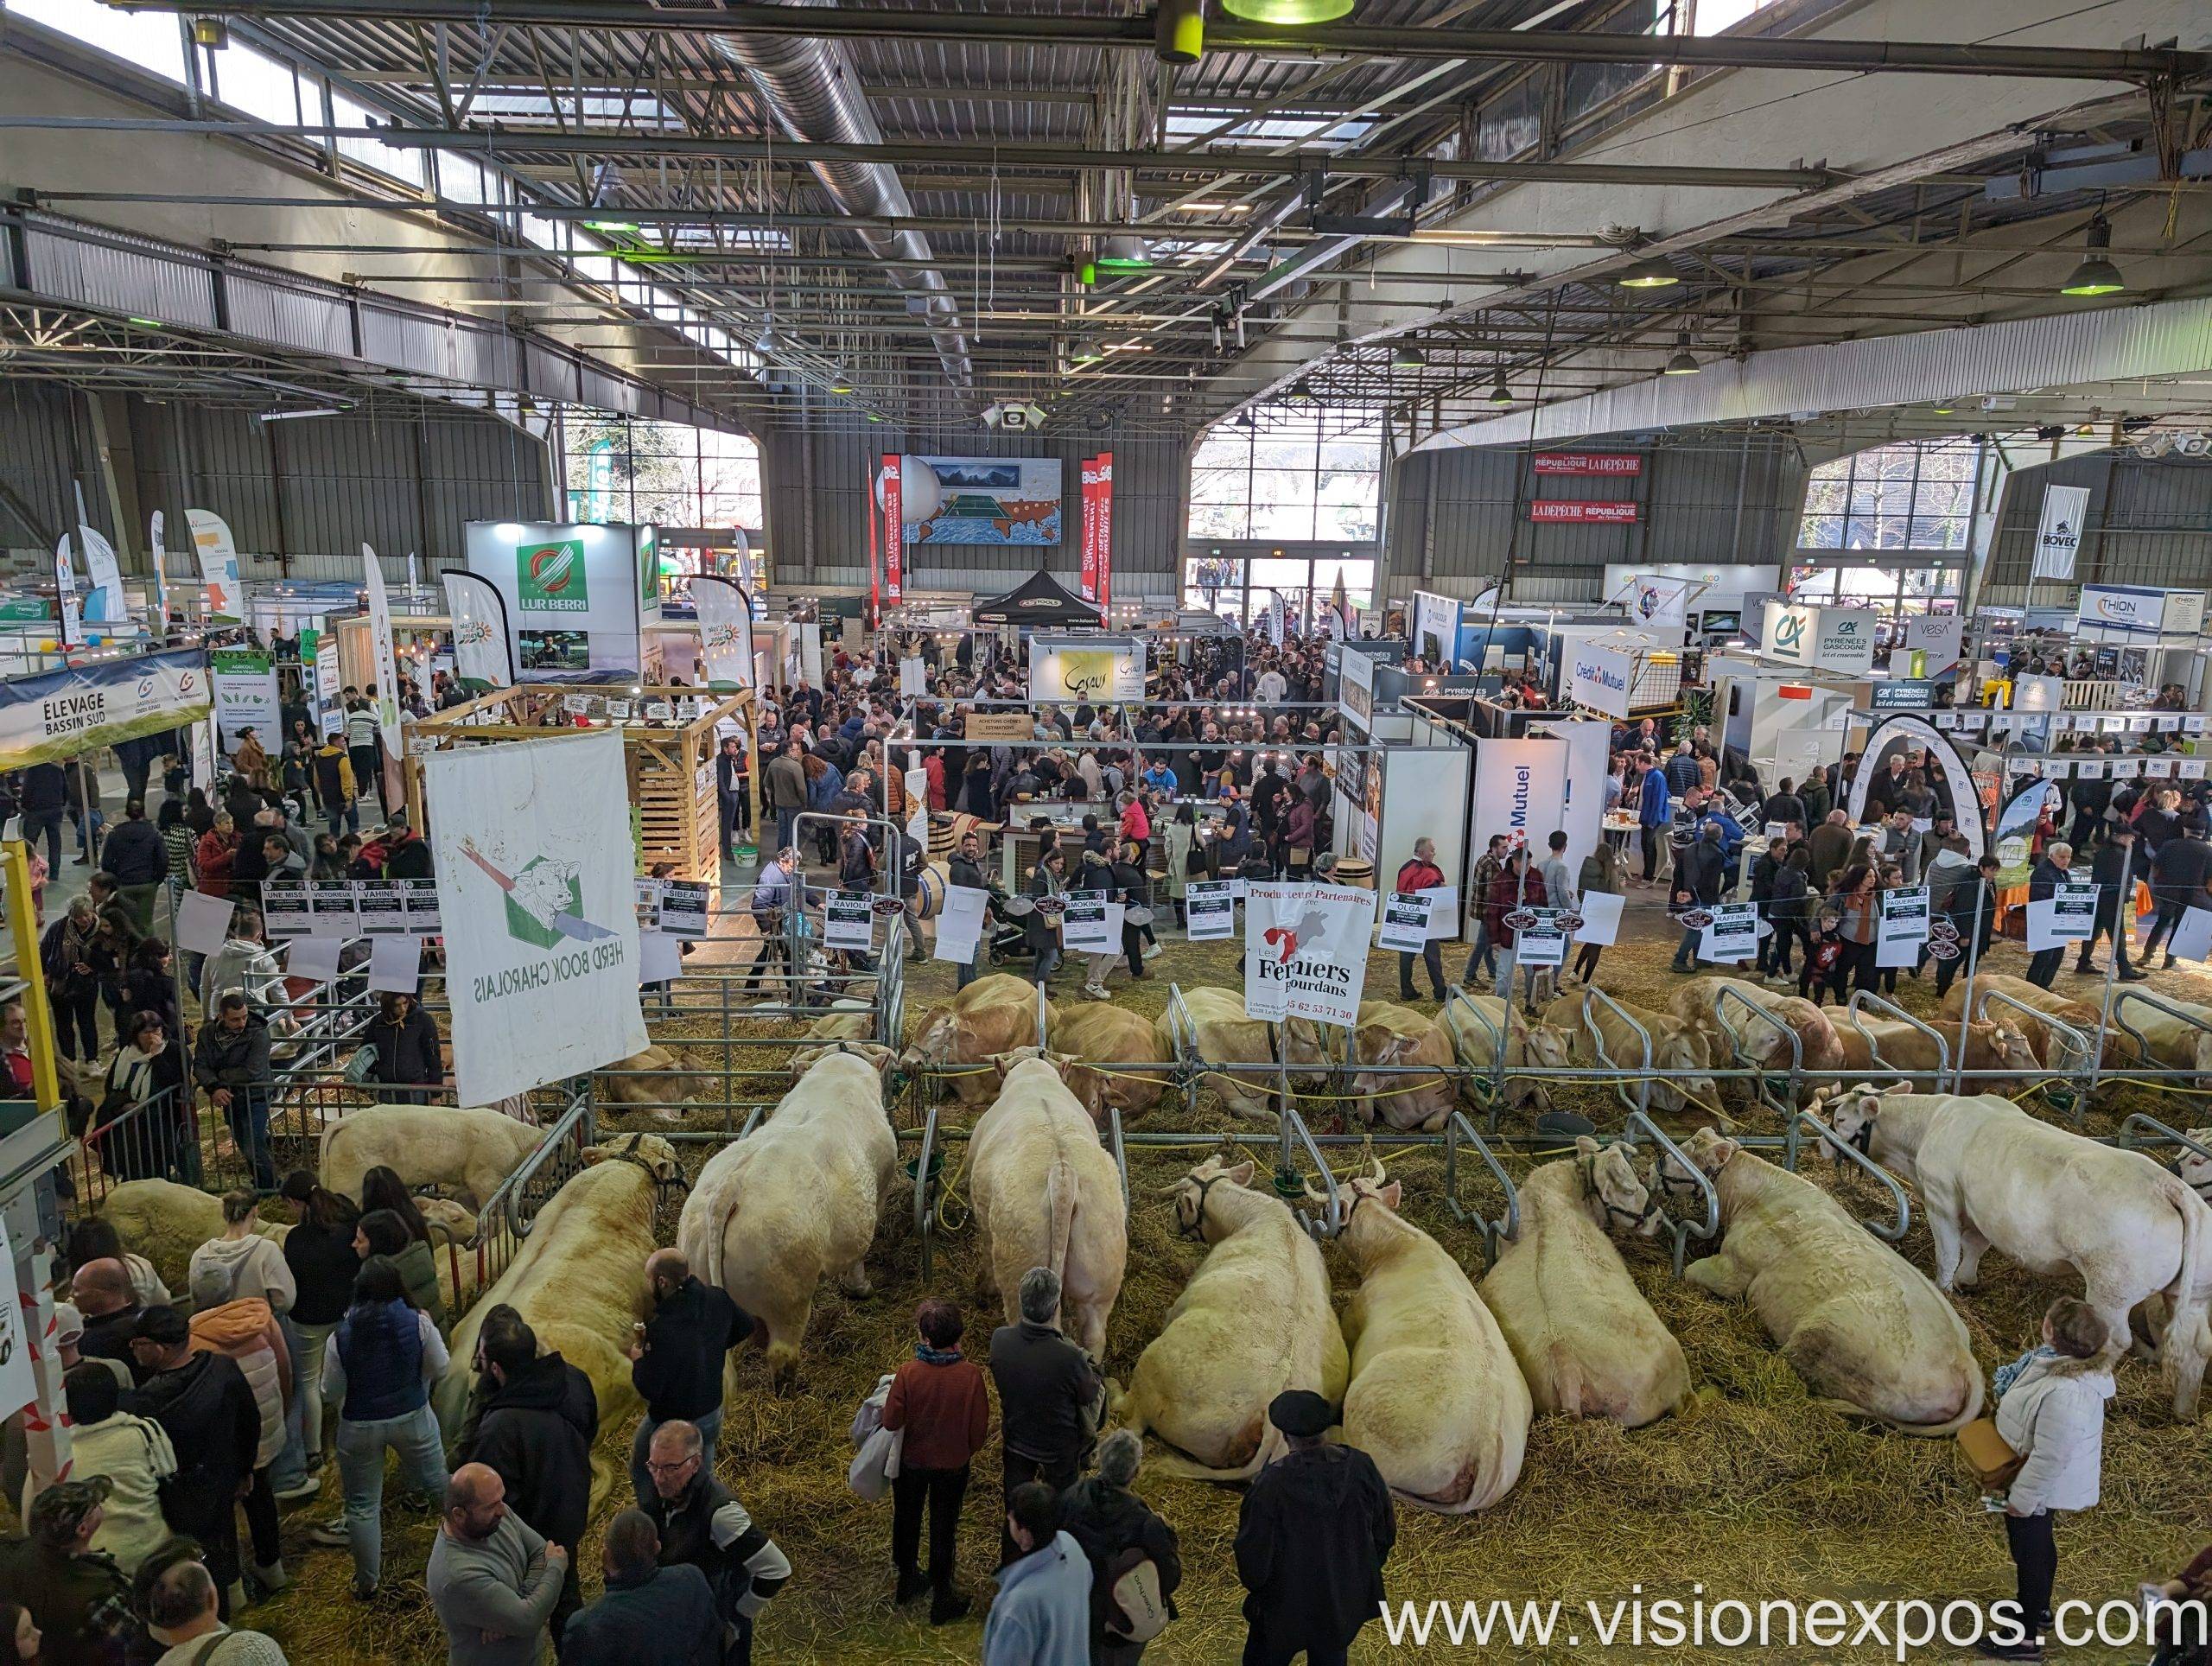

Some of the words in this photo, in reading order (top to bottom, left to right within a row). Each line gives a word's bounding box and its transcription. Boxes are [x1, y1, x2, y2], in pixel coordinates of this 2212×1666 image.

[1535, 458, 1587, 467] RÉPUBLIQUE
[1588, 460, 1599, 470] LA
[1600, 458, 1639, 471] DÉPÊCHE
[1533, 505, 1543, 516] LA
[1544, 504, 1583, 517] DÉPÊCHE
[1586, 506, 1636, 516] RÉPUBLIQUE
[522, 598, 547, 609] LUR
[548, 599, 587, 610] BERRI
[1576, 661, 1595, 682] Crédit
[1602, 670, 1625, 692] Mutuel
[44, 692, 105, 722] ÉLEVAGE
[46, 715, 84, 735] BASSIN
[87, 711, 105, 727] SUD
[1510, 766, 1530, 827] Mutuel
[669, 890, 702, 900] SIBEAU
[1315, 889, 1372, 906] Partenaires
[834, 900, 866, 909] RAVIOLI
[1065, 900, 1103, 909] SMOKING
[1397, 903, 1421, 913] OLGA
[1717, 913, 1751, 922] RAFFINEE
[1258, 948, 1276, 957] Les
[1298, 1002, 1310, 1012] 62
[1312, 1004, 1324, 1014] 53
[1326, 1008, 1337, 1017] 71
[1339, 1010, 1352, 1021] 30
